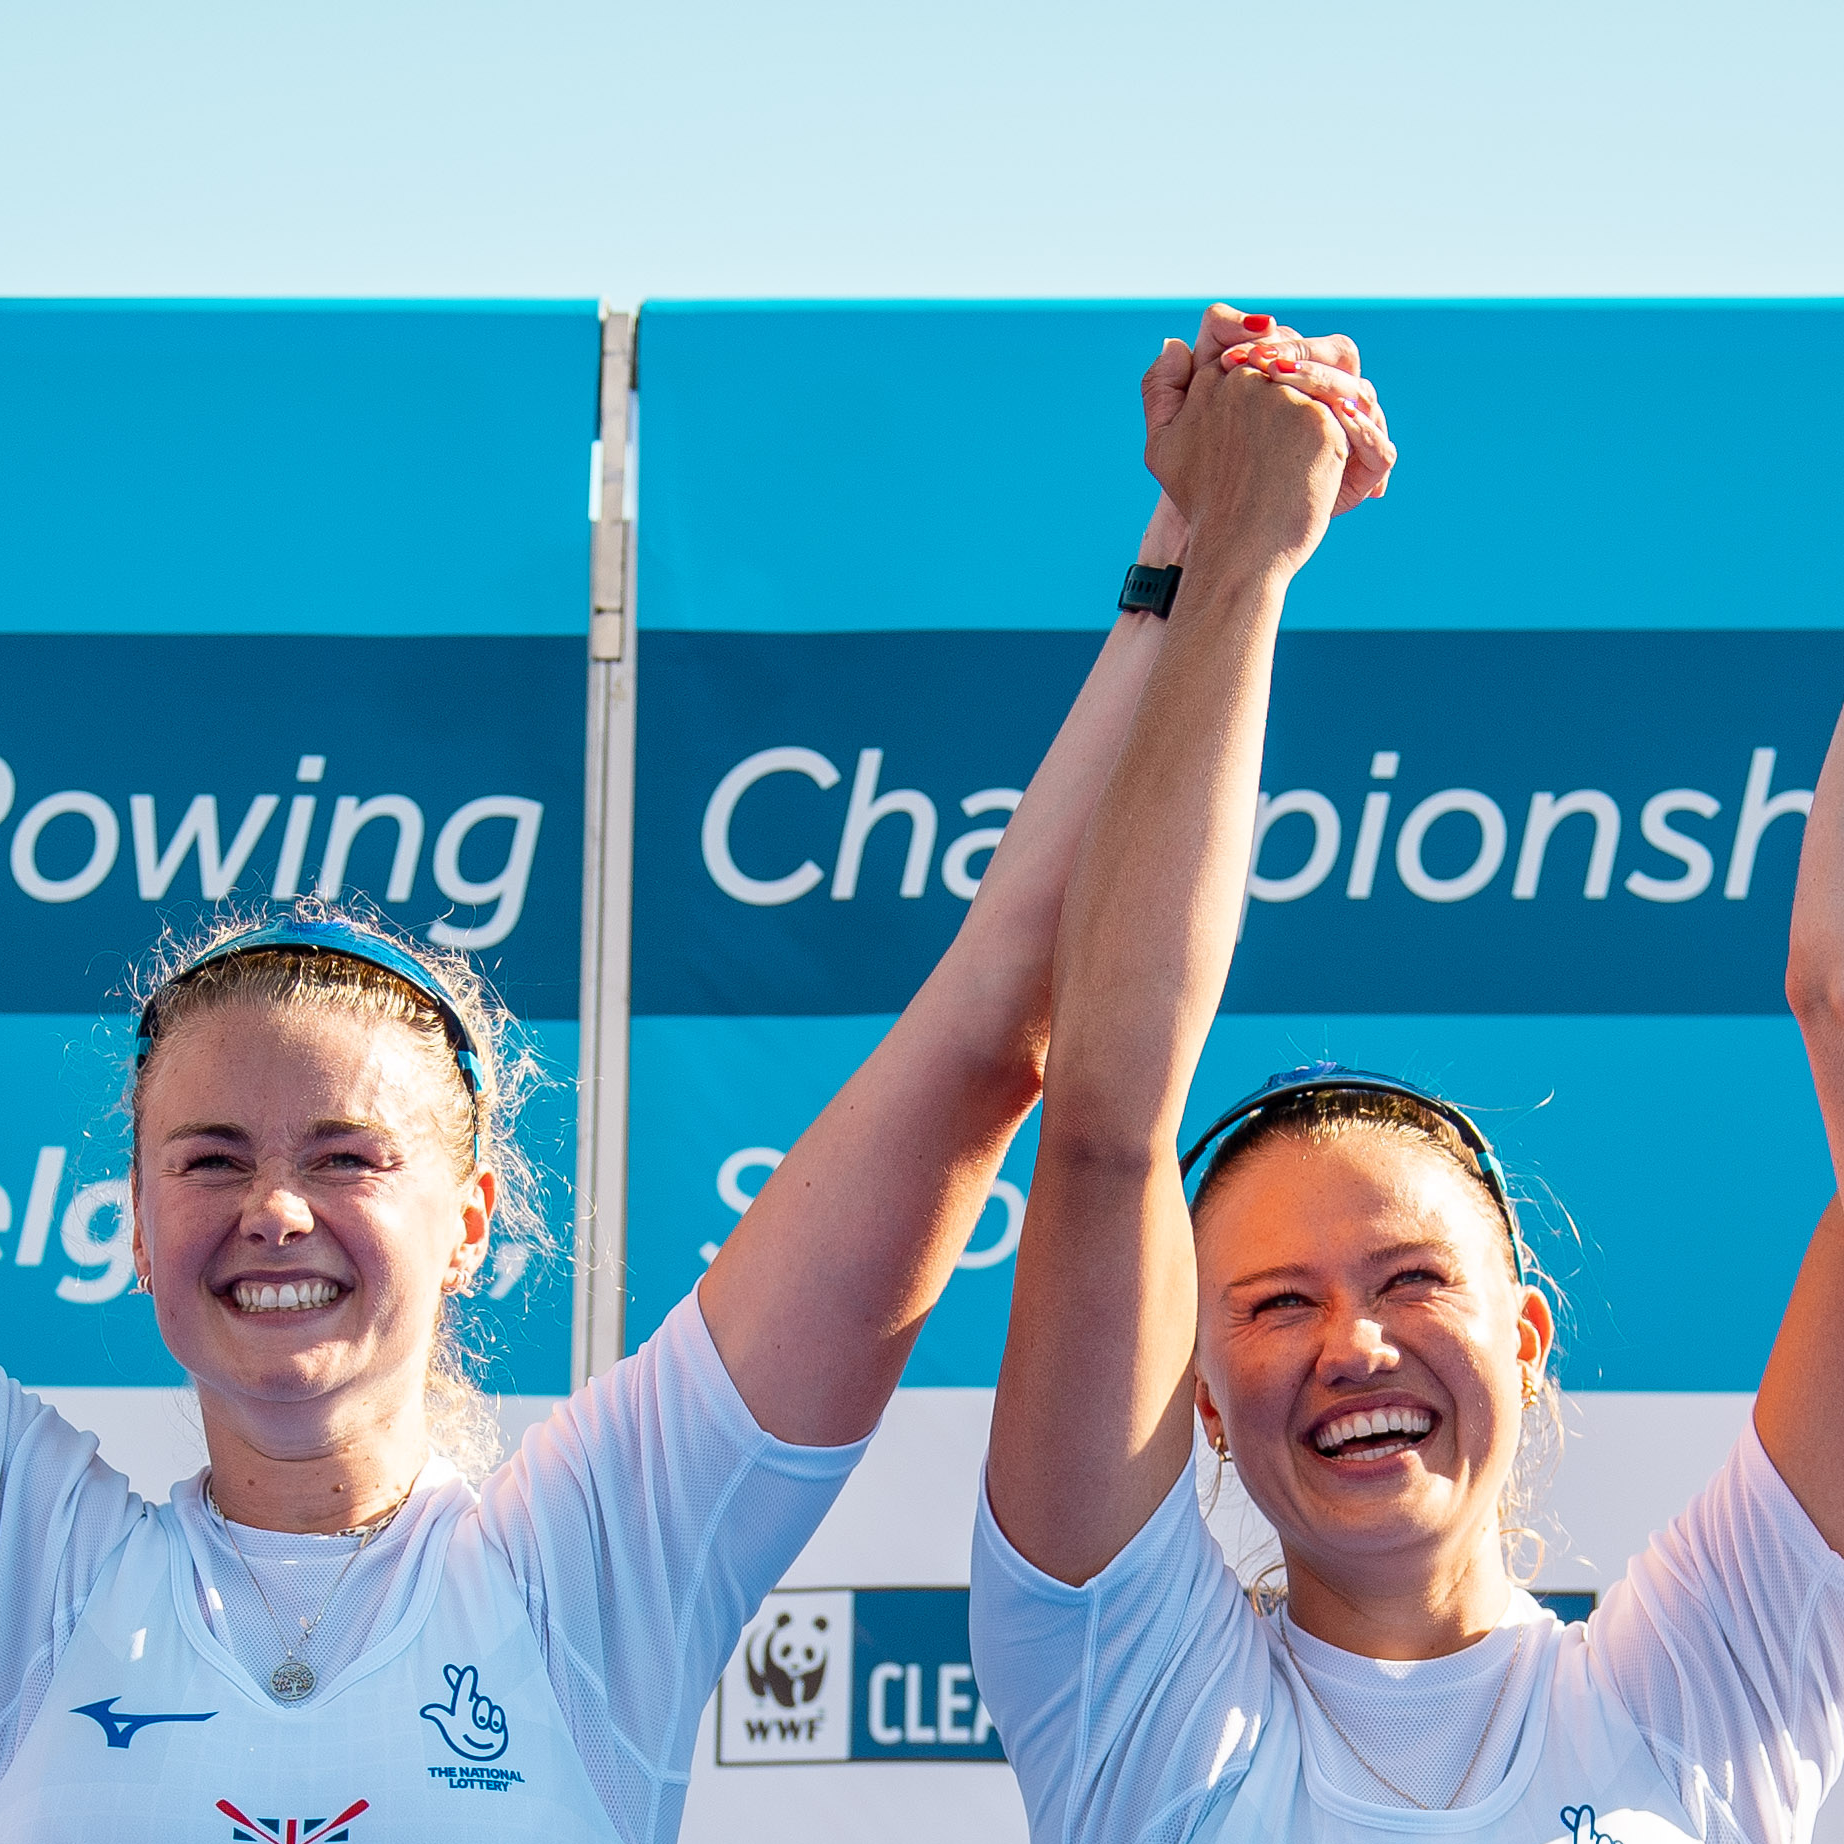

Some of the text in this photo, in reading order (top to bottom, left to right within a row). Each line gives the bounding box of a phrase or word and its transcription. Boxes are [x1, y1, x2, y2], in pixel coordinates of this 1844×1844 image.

[700, 745, 1817, 945] Chapionsh
[745, 1716, 822, 1743] WWF
[427, 1766, 525, 1783] THE NATIONAL
[449, 1778, 510, 1792] LOTTERY
